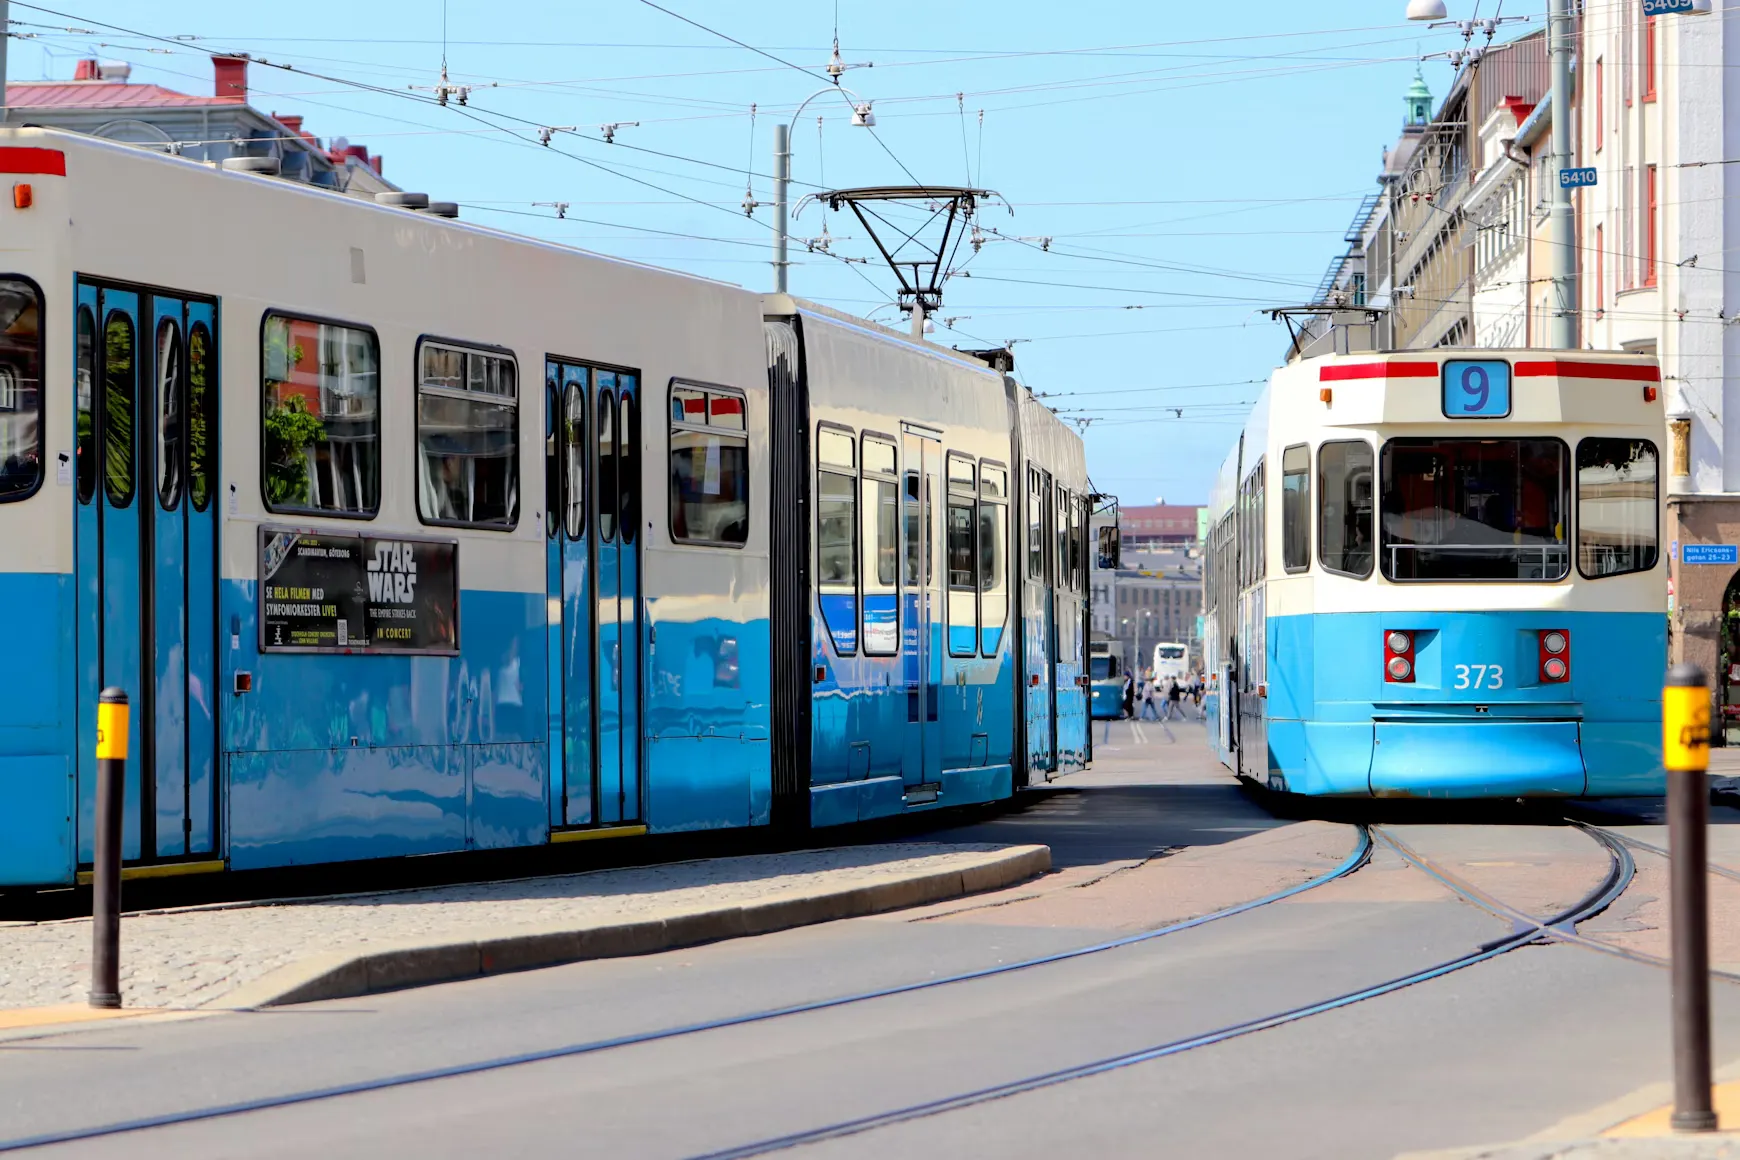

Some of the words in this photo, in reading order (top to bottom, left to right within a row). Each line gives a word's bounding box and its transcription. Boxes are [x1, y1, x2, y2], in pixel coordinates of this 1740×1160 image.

[1561, 171, 1596, 184] 5410
[1461, 365, 1490, 412] 9
[329, 547, 350, 558] GÖTEBORG
[367, 541, 417, 573] STAR
[265, 586, 273, 599] SE
[274, 587, 289, 600] HELA
[290, 587, 311, 600] FILMEN
[311, 587, 325, 600] MED
[367, 572, 417, 603] WARS
[266, 603, 321, 617] SYMFONIORKESTER
[321, 604, 337, 617] LIVE!
[369, 608, 378, 618] THE
[378, 608, 391, 618] EMPIRE
[376, 627, 384, 639] IN
[385, 627, 412, 639] CONCERT
[1454, 664, 1504, 689] 373
